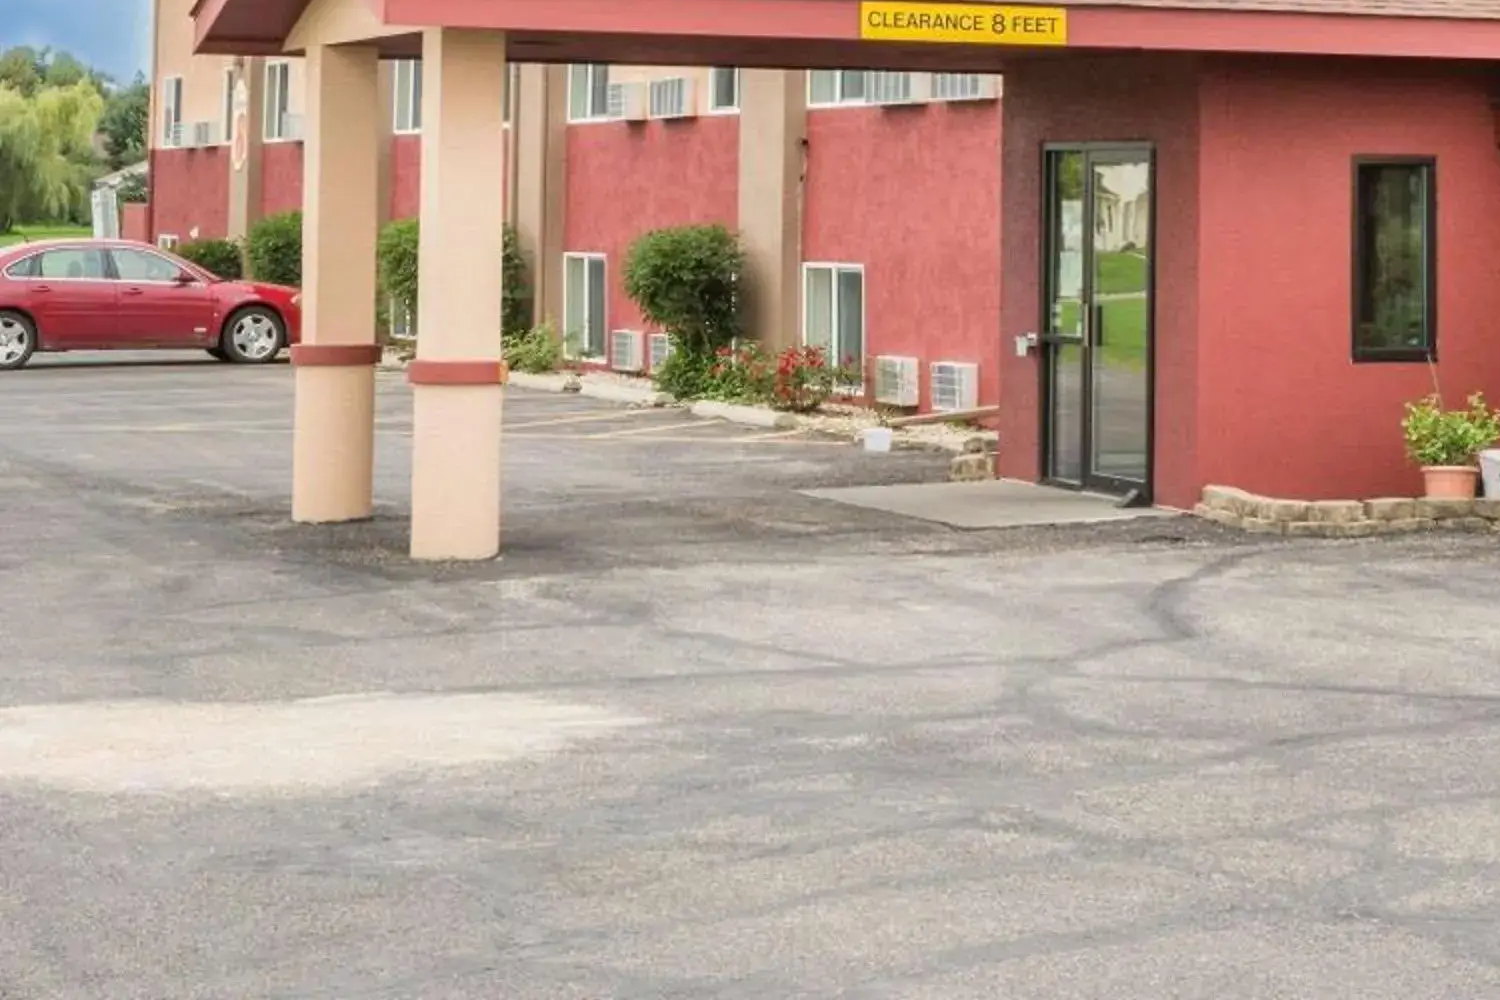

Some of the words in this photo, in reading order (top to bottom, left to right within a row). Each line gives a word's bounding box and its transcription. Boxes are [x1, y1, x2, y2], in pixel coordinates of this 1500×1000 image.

[867, 10, 985, 31] CLEARANCE
[991, 13, 1006, 35] 8
[1011, 16, 1059, 34] FEET
